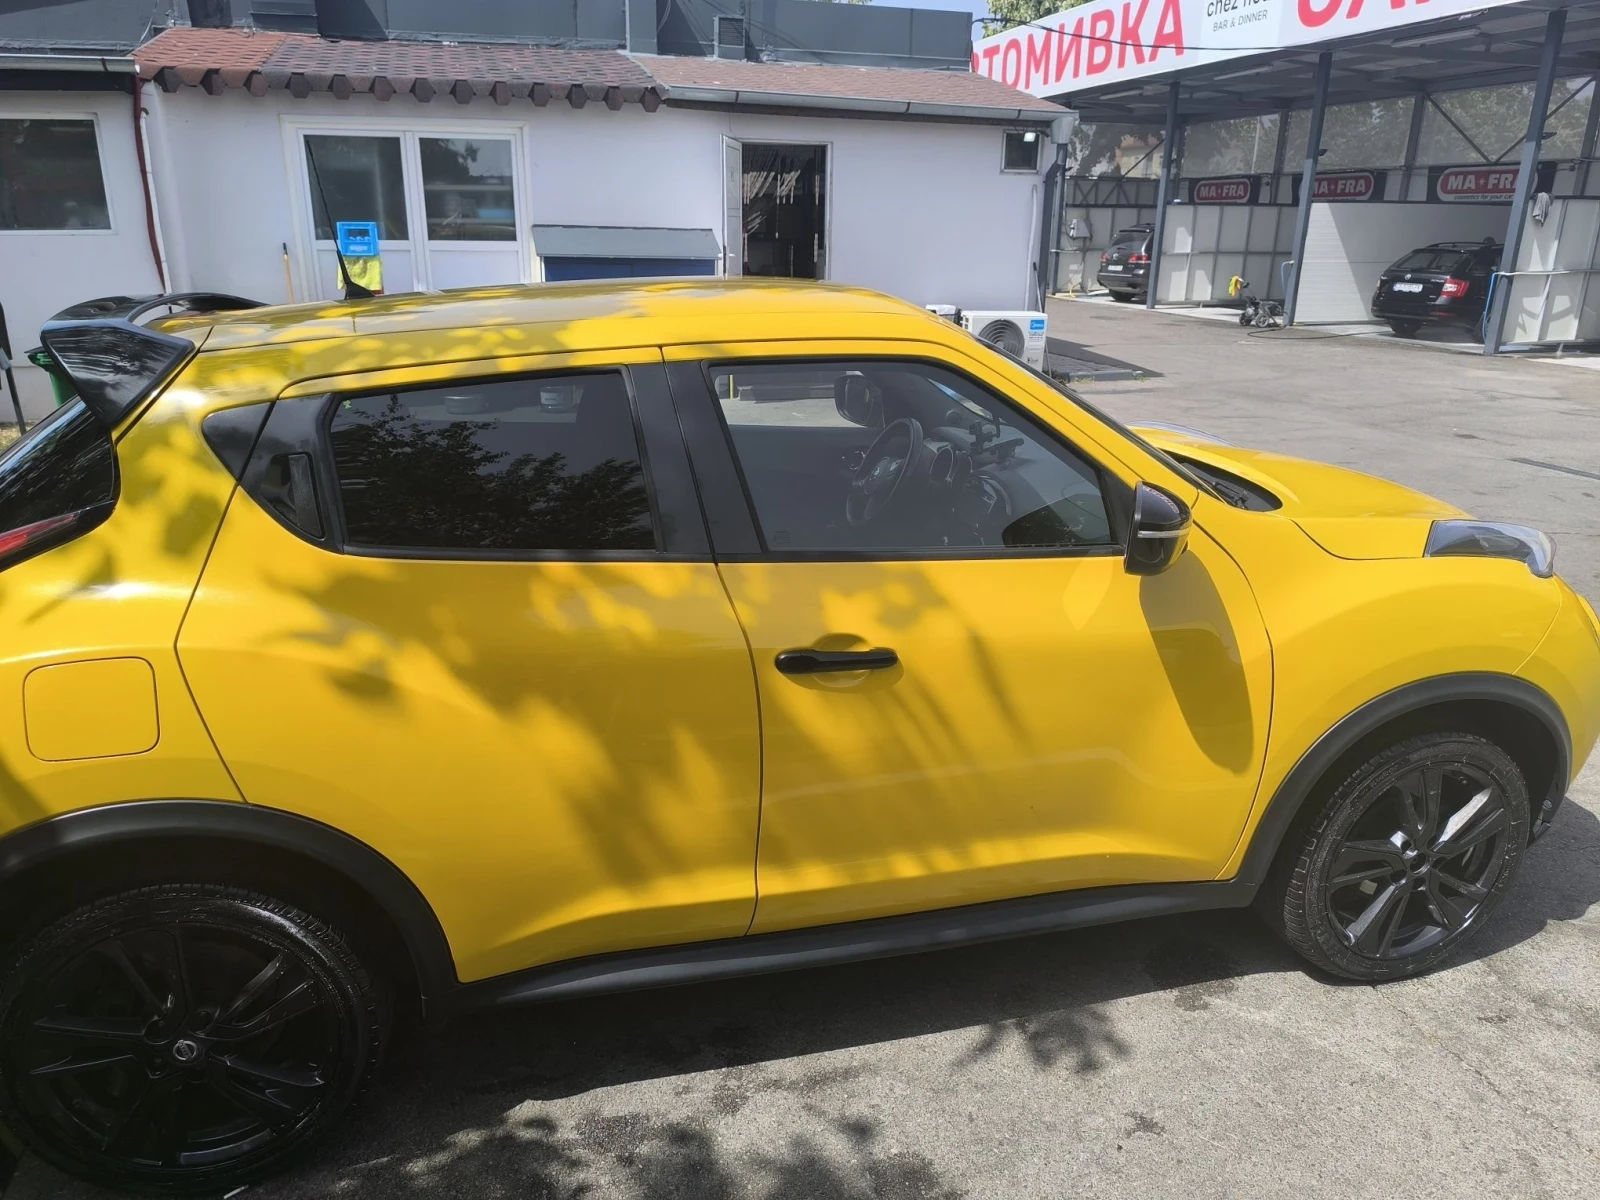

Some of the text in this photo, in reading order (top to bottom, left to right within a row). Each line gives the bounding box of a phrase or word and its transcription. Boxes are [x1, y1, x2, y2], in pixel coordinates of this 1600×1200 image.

[1213, 9, 1268, 32] BAR & DINNER
[1336, 179, 1366, 193] FRA
[1487, 173, 1517, 189] FR
[1222, 184, 1245, 197] FRA
